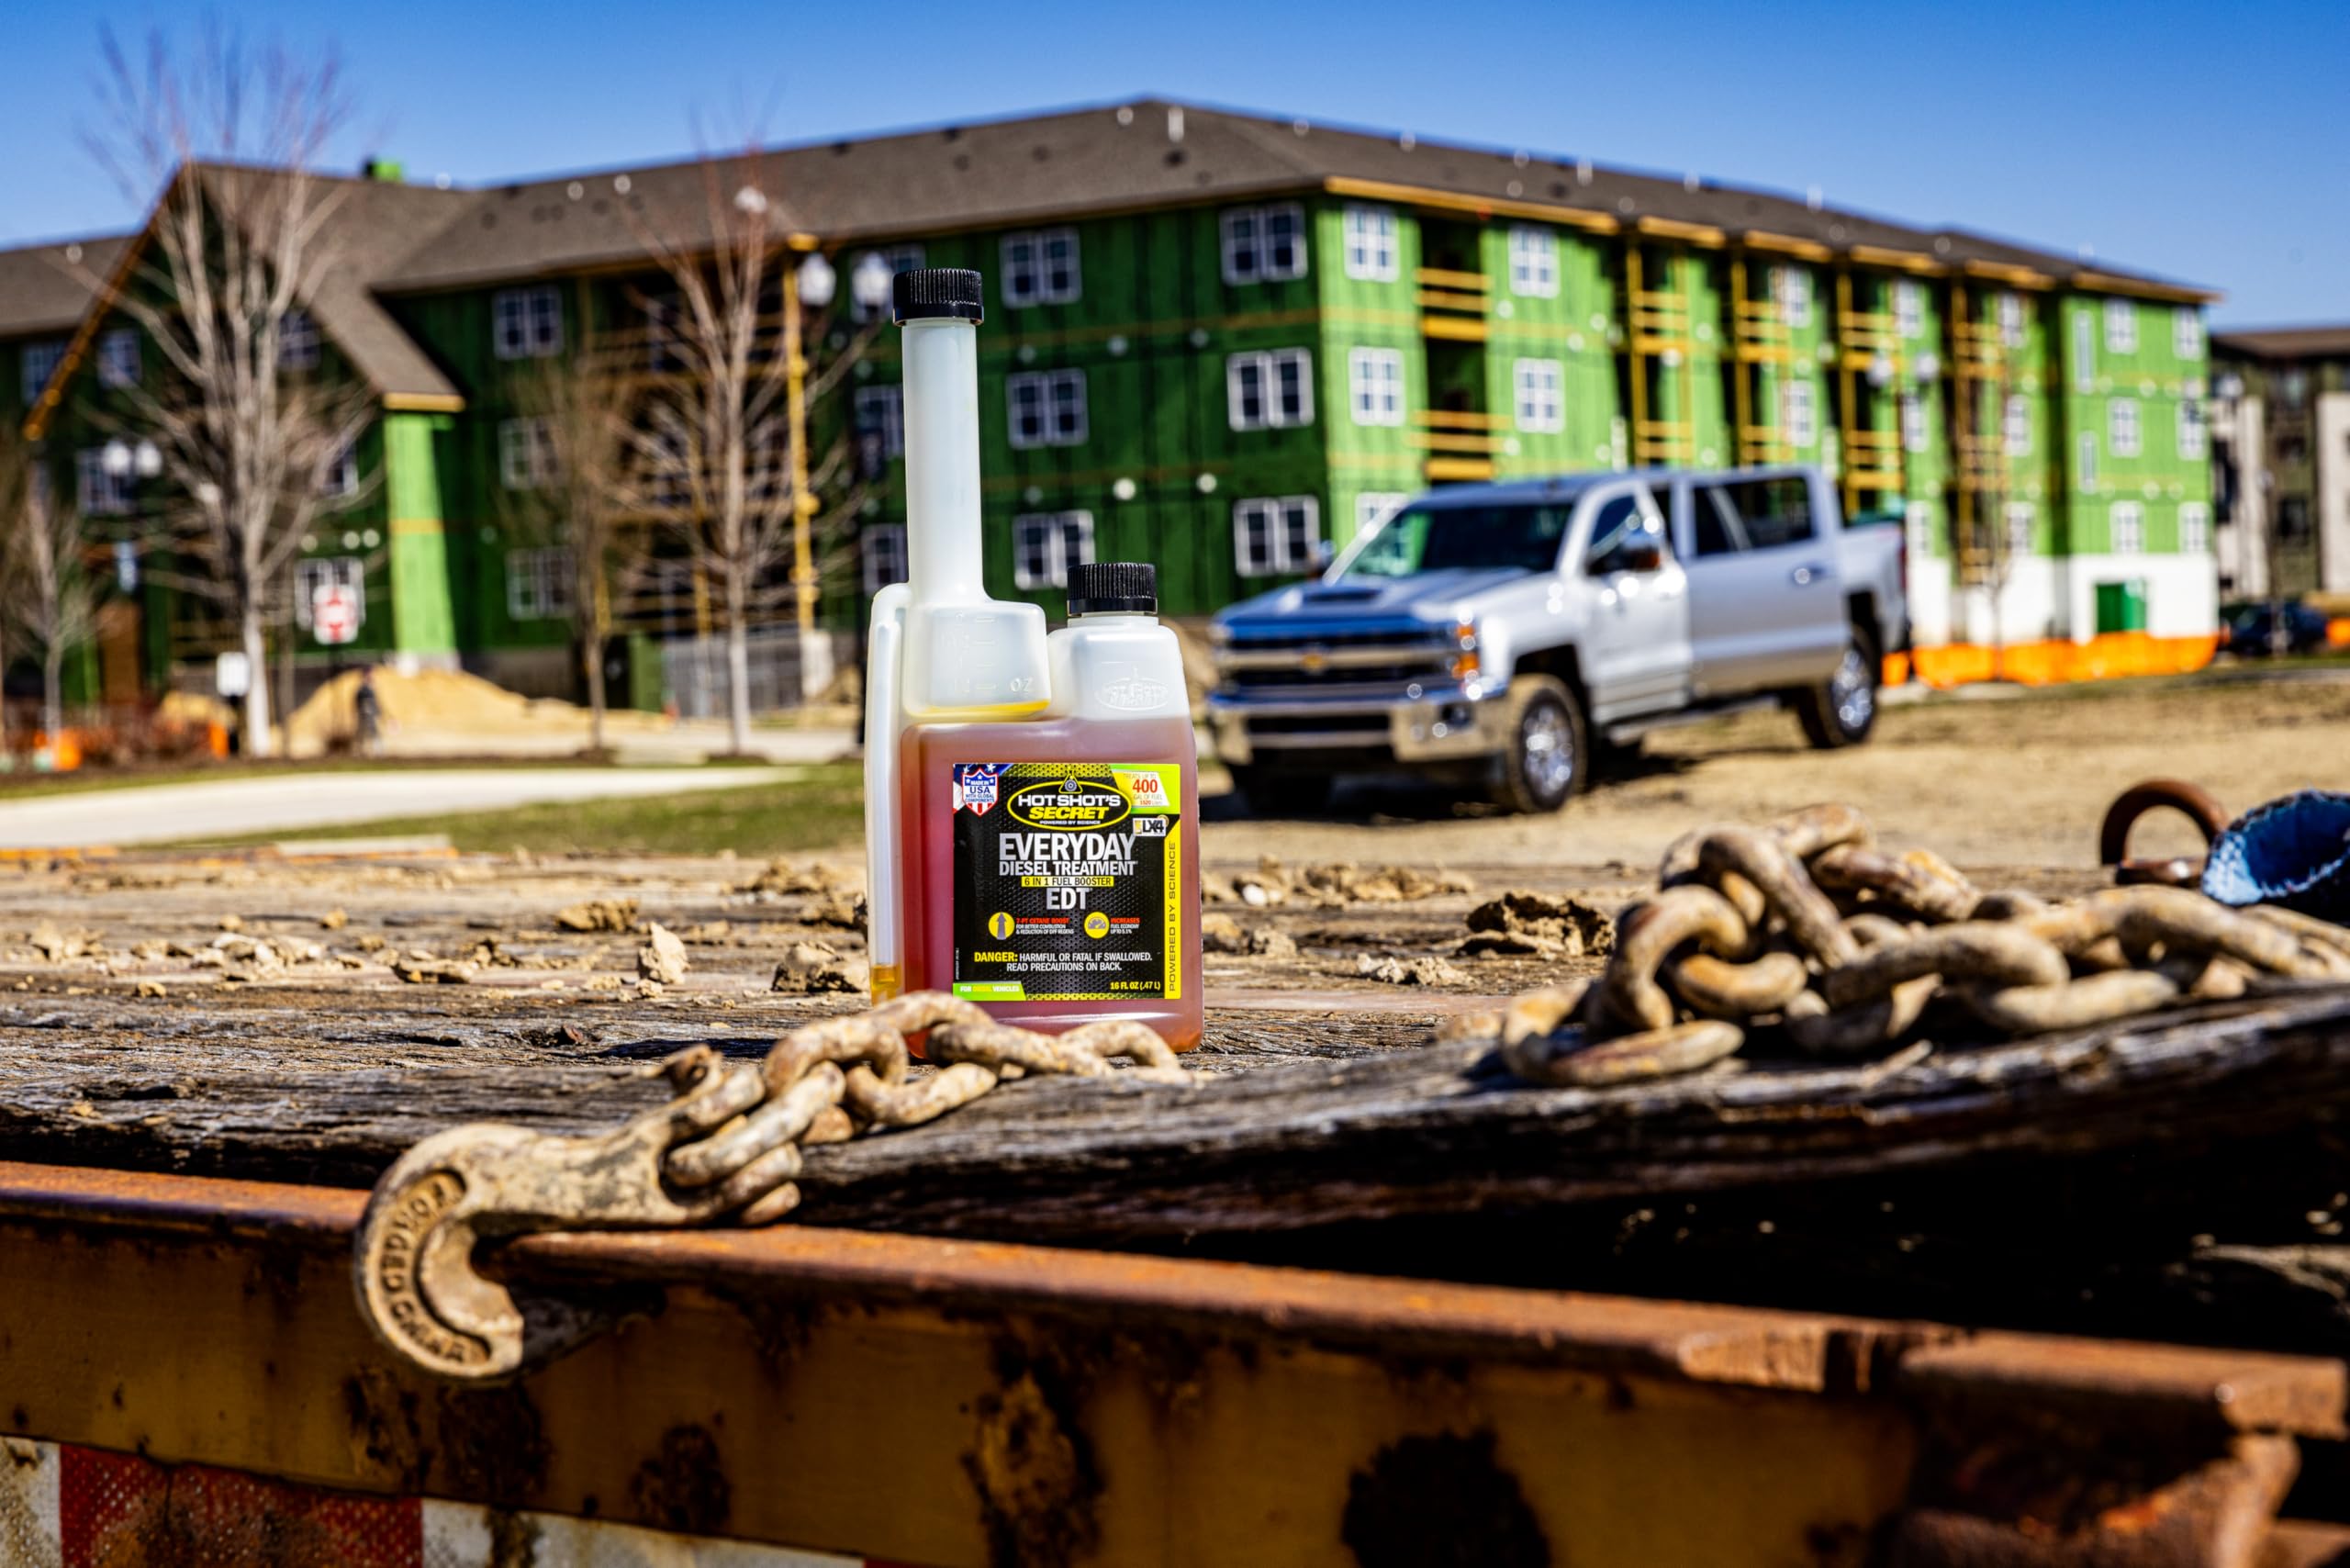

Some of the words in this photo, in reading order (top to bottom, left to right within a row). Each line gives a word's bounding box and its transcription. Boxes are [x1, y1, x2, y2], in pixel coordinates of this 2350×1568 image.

[969, 786, 990, 794] USA
[1132, 778, 1158, 793] 400
[1018, 794, 1056, 807] HOT
[1057, 794, 1121, 807] SHOT'S
[1028, 806, 1109, 820] SECRET
[999, 833, 1136, 861] EVERYDAY
[999, 861, 1051, 877] DIESEL
[1052, 860, 1136, 876] TREATMENT
[1024, 878, 1030, 886] 6
[1074, 877, 1111, 885] BOOSTER
[1046, 887, 1090, 910] EDT
[1169, 904, 1176, 922] BY
[974, 951, 1018, 963] DANGER:
[1019, 953, 1057, 962] HARMFUL
[1058, 953, 1070, 961] OR
[1072, 953, 1093, 961] FATAL
[1095, 953, 1102, 961] IF
[1103, 952, 1153, 961] SWALLOWED.
[1006, 963, 1028, 971] READ
[1030, 963, 1083, 971] PRECAUTIONS
[1086, 962, 1098, 971] ON
[1100, 962, 1123, 971] BACK.
[1110, 981, 1119, 990] 16
[1120, 981, 1128, 990] FL
[1129, 981, 1139, 990] OZ
